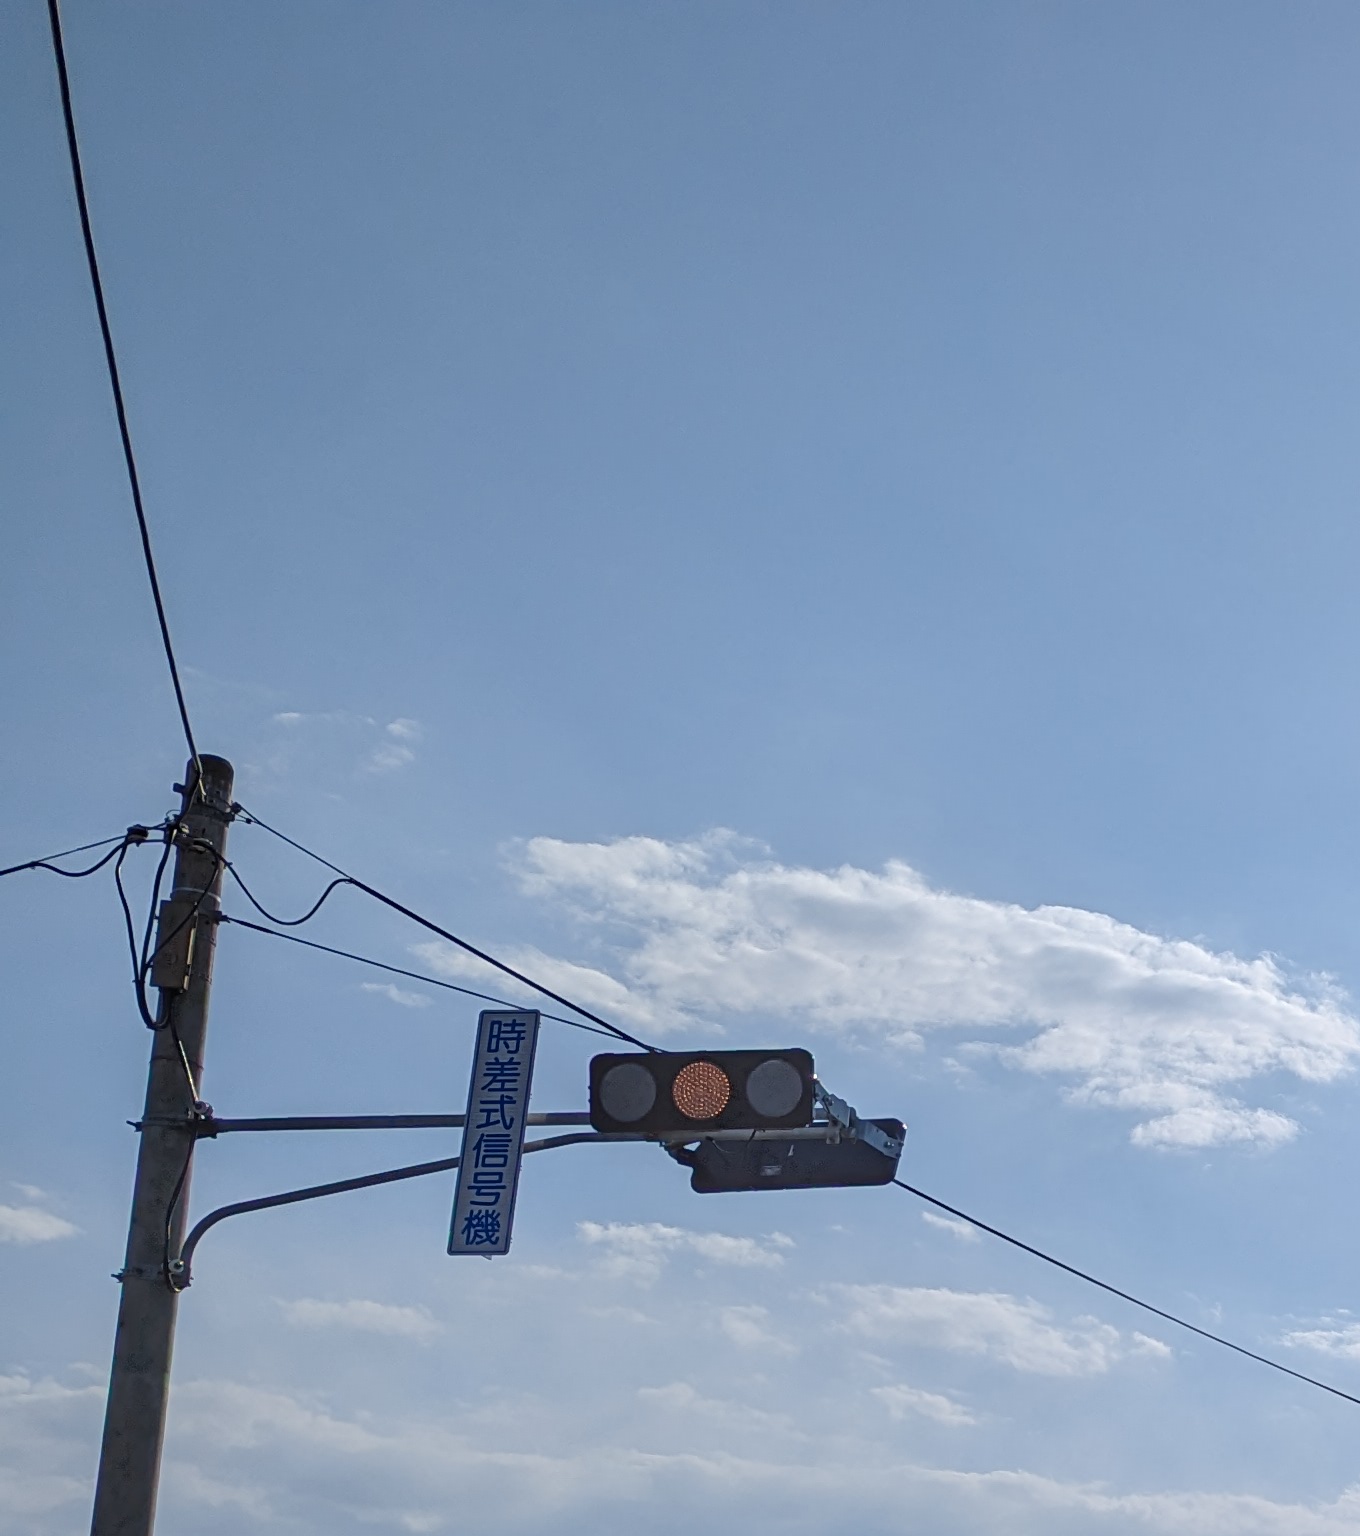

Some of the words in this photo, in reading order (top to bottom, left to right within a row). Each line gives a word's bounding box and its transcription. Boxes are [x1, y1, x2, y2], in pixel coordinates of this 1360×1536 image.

[461, 1018, 527, 1246] 時差式信号機
